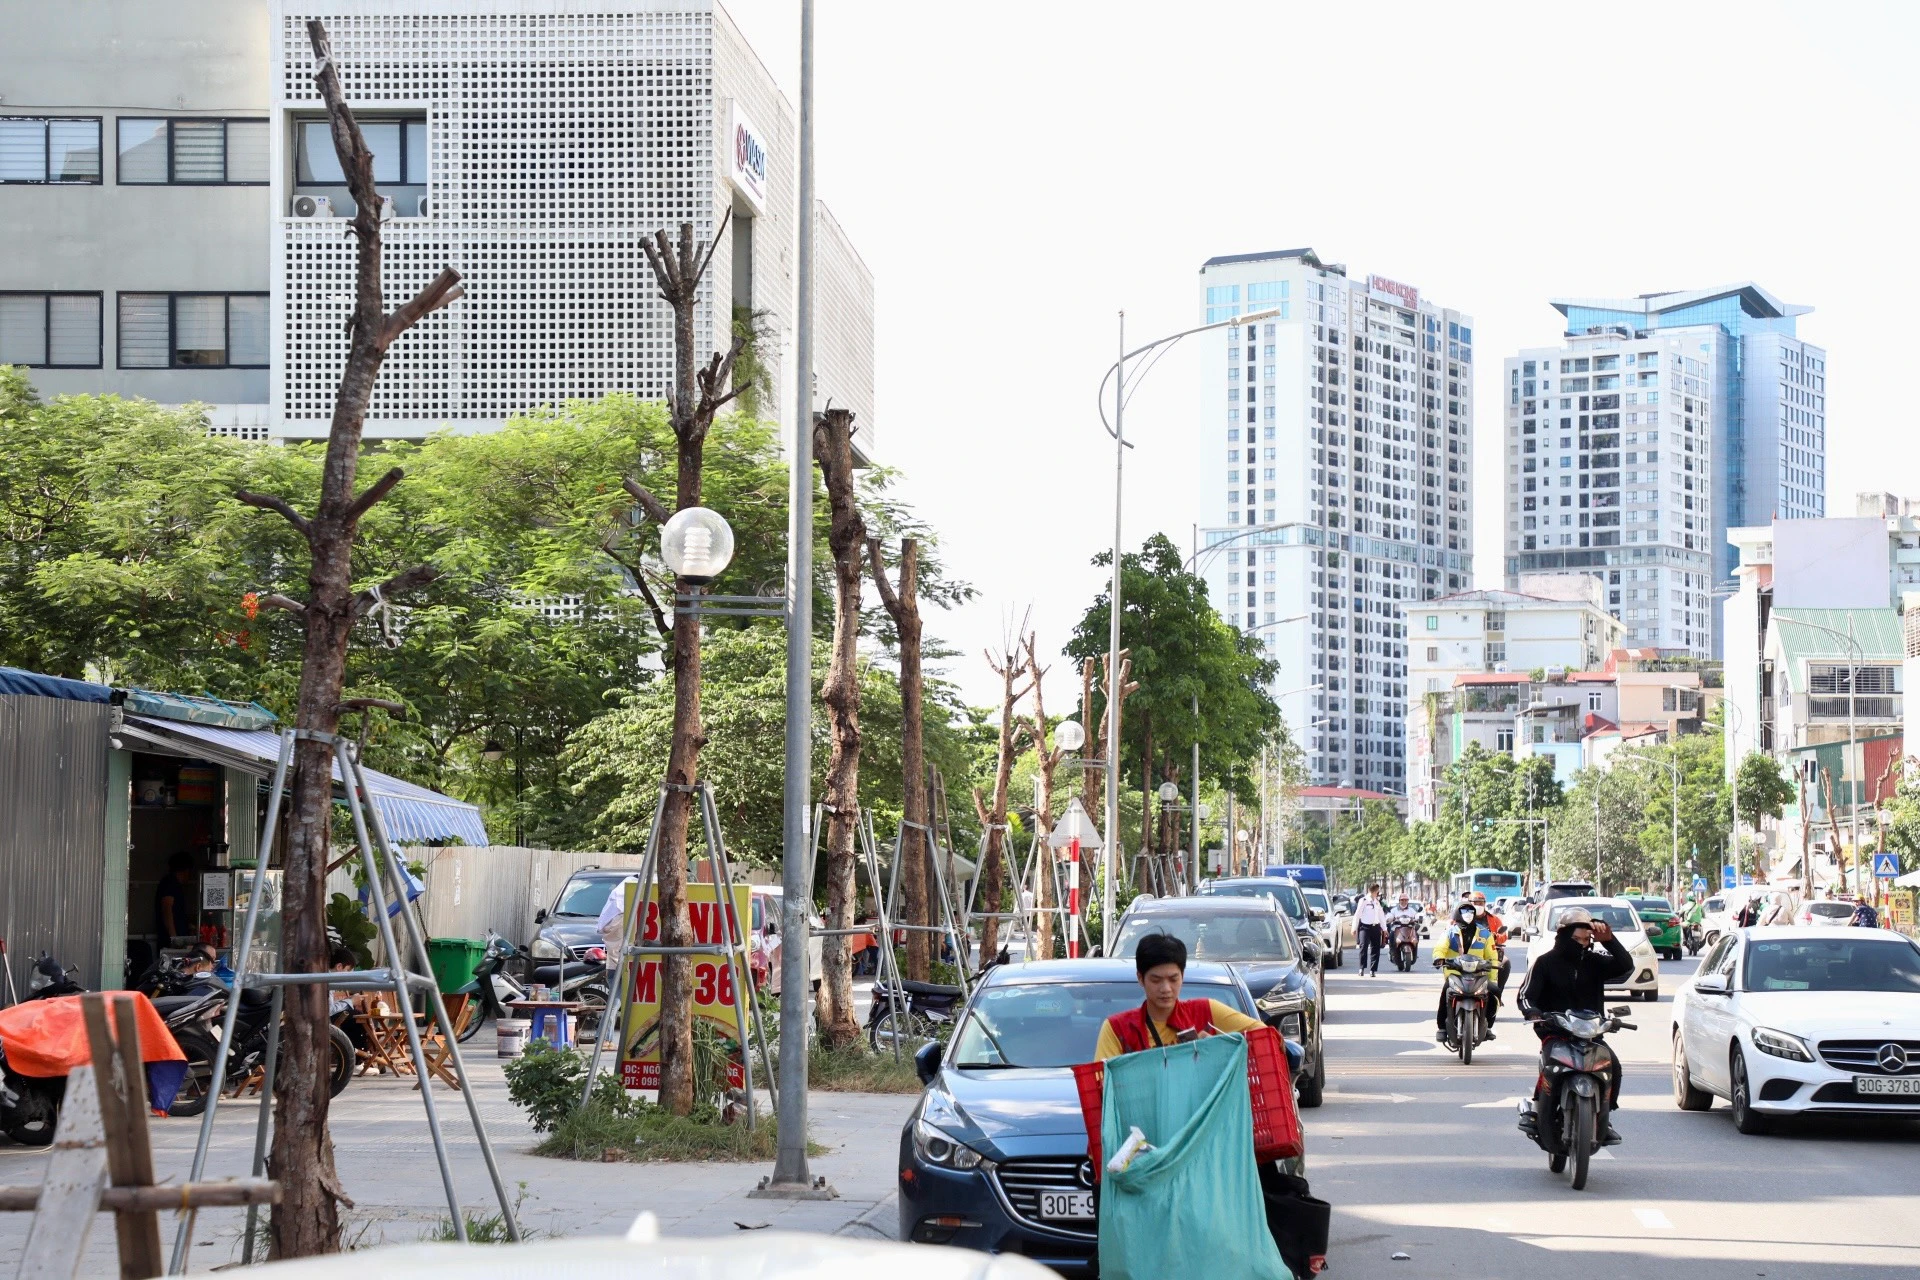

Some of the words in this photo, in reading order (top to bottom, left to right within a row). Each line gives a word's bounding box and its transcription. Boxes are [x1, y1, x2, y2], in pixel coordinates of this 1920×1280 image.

[636, 900, 735, 944] BNH
[695, 963, 739, 1006] 36
[641, 1076, 660, 1086] 098
[1859, 1079, 1920, 1093] 30G-378.0
